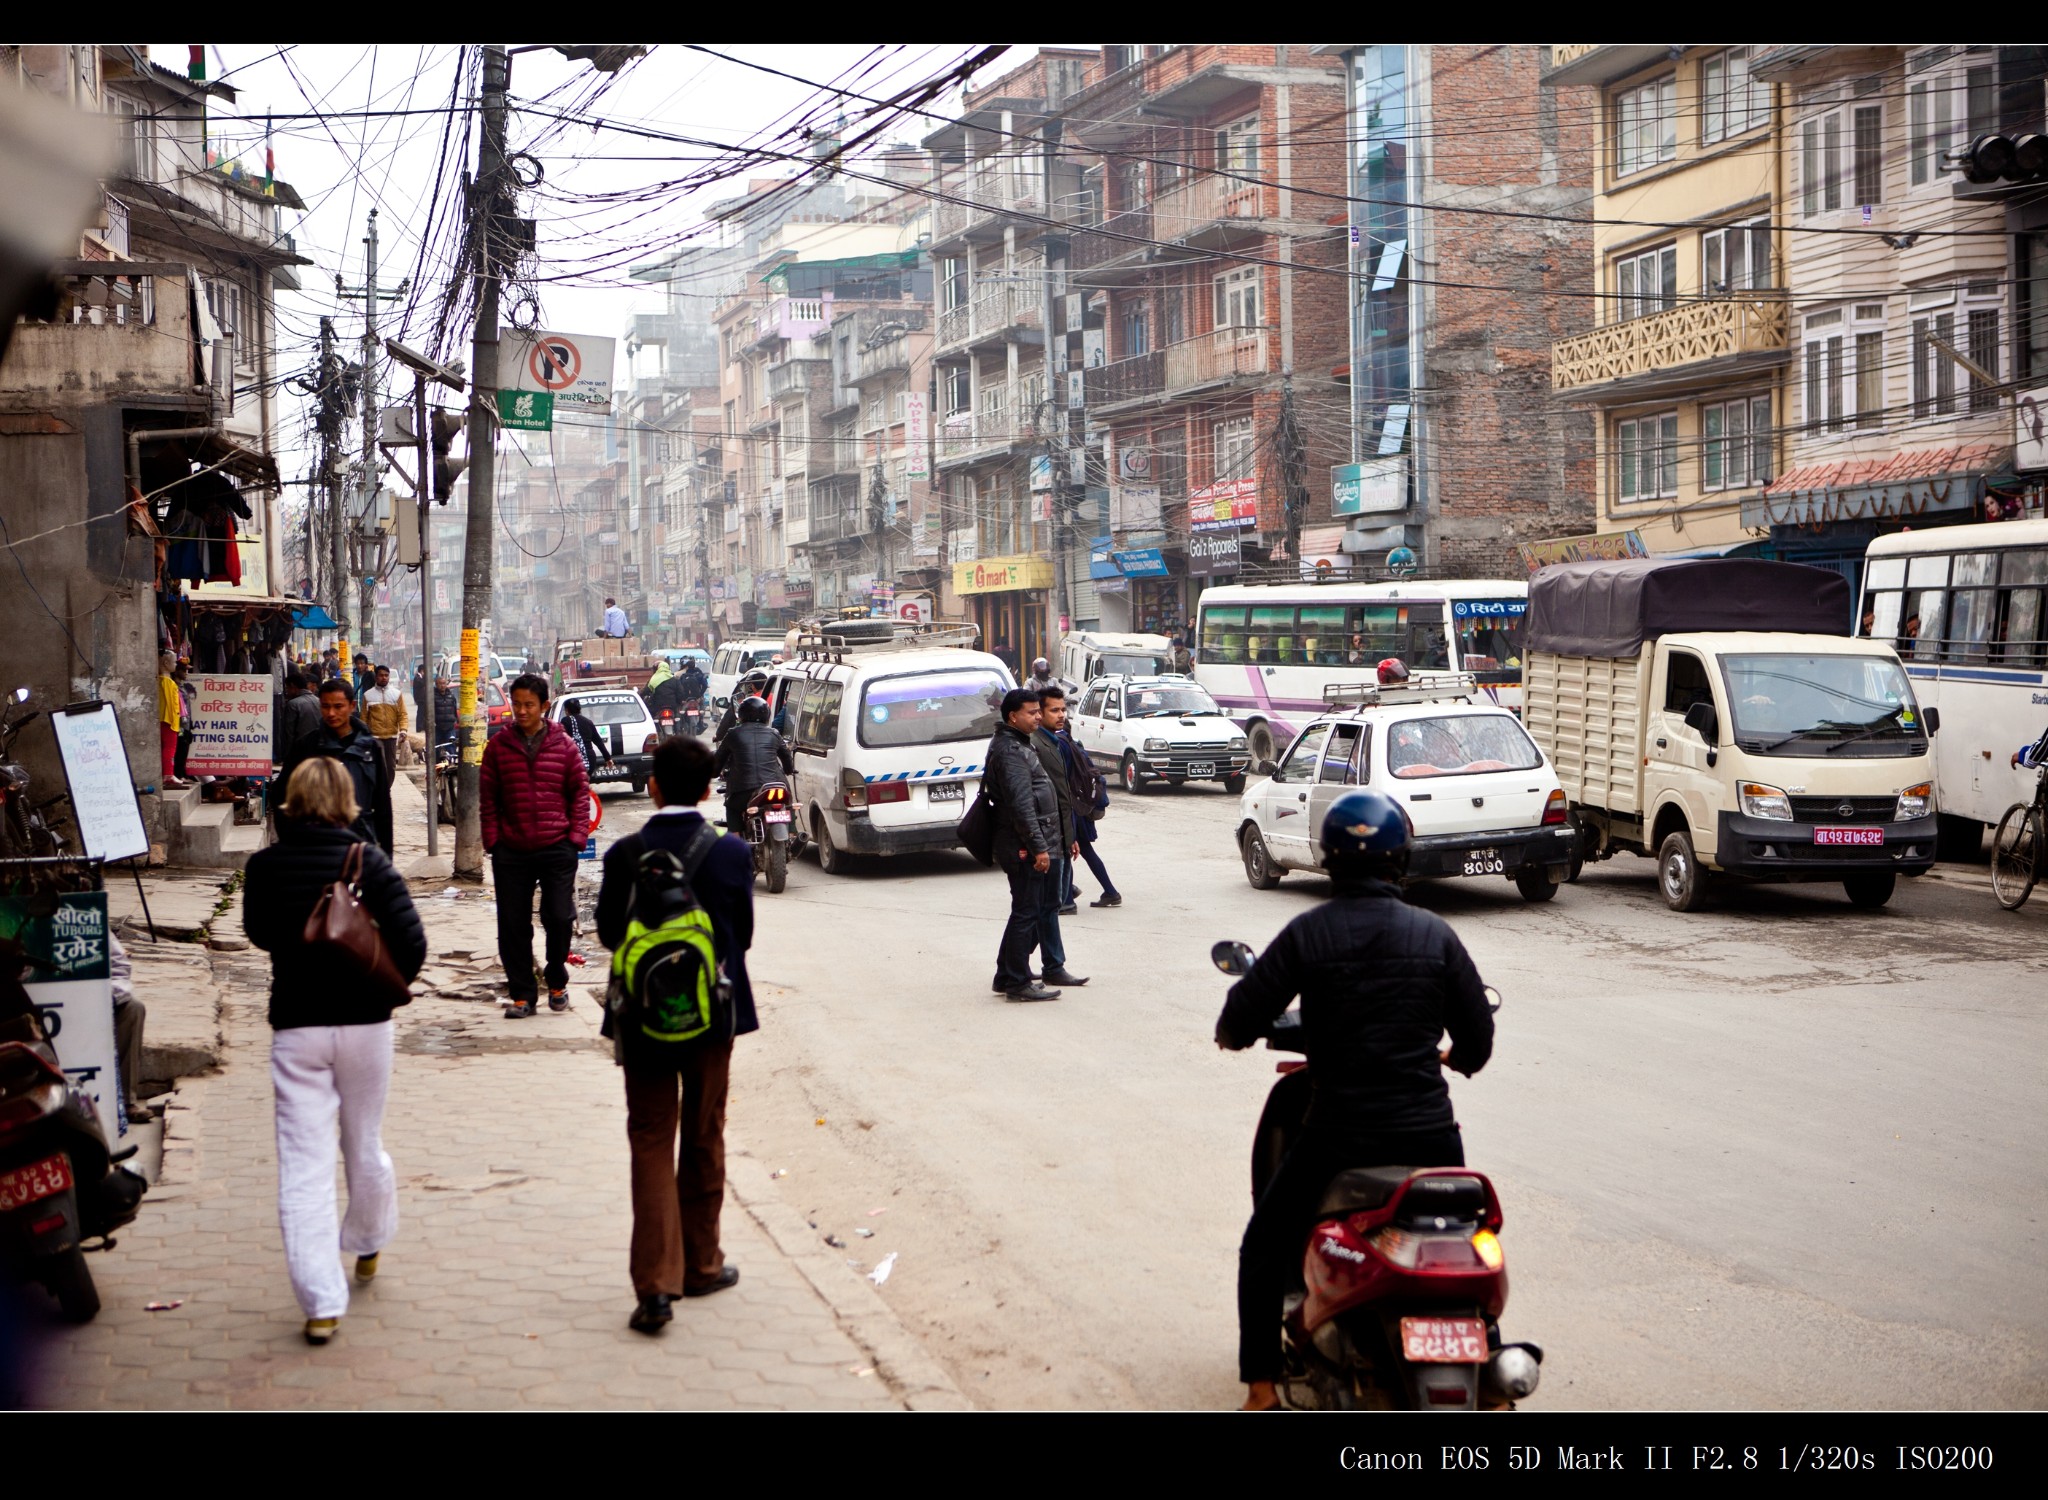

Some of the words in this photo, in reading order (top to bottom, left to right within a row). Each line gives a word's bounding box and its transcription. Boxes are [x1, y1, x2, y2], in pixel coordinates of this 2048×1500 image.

[908, 393, 924, 472] IMPRESSION
[1238, 482, 1255, 492] Press
[1334, 482, 1358, 502] Carlsberg
[1208, 534, 1238, 560] Apparels
[1578, 538, 1625, 550] Shop
[975, 564, 984, 588] G
[986, 568, 1007, 586] mart
[1471, 603, 1504, 613] सिटी
[204, 678, 236, 692] विजय
[240, 679, 266, 692] हेयर
[579, 696, 635, 705] SUZUKI
[211, 721, 238, 730] HAIR
[229, 734, 268, 743] SAILON
[1464, 860, 1503, 874] ४०७०
[52, 924, 102, 938] TUBORG
